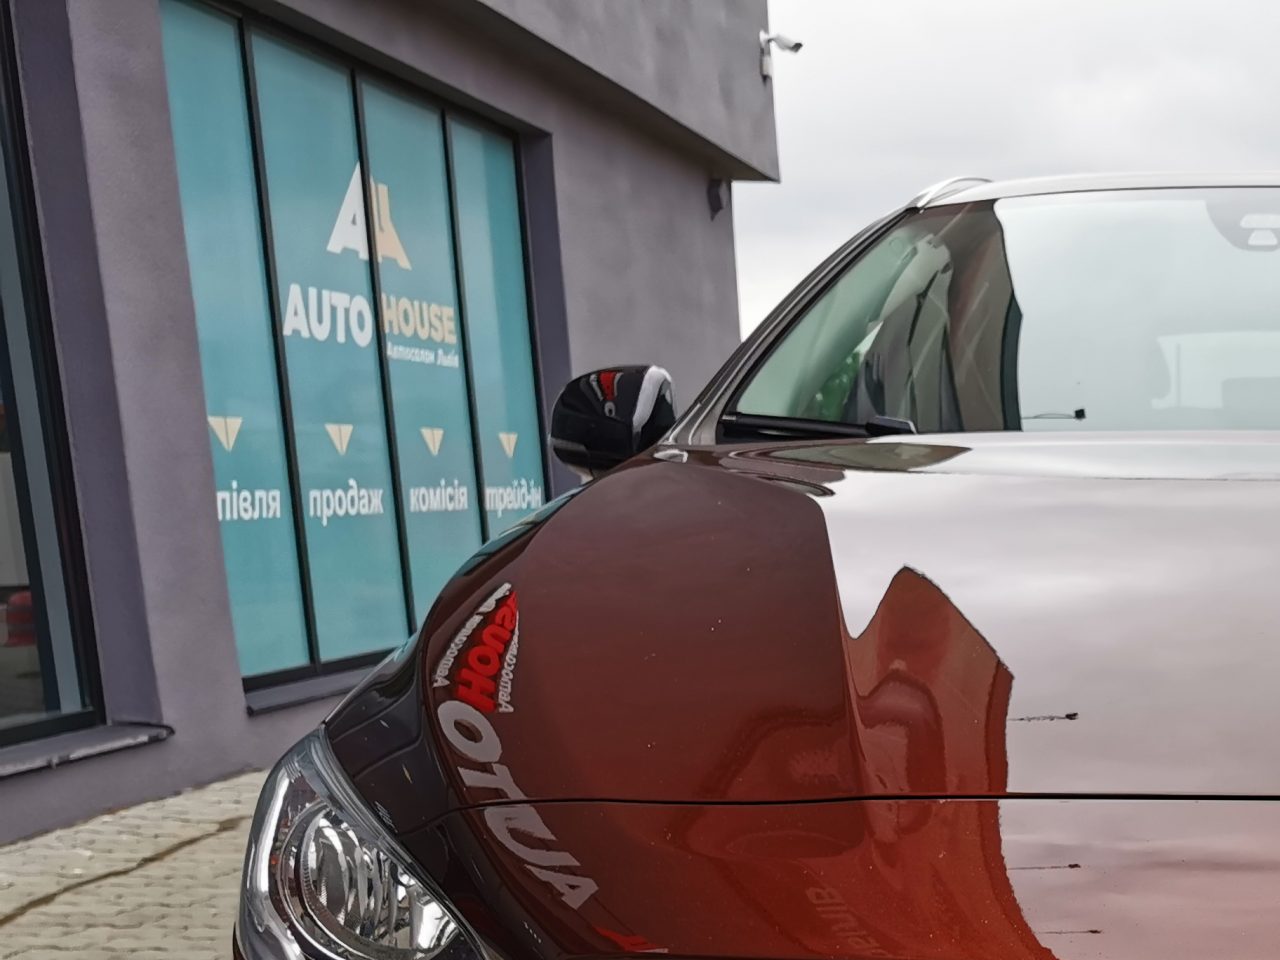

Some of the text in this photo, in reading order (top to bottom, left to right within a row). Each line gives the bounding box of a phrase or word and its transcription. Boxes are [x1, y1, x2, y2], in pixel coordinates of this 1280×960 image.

[283, 283, 457, 347] AUTO HOUSE
[309, 478, 384, 527] продаж
[410, 478, 468, 512] комісія
